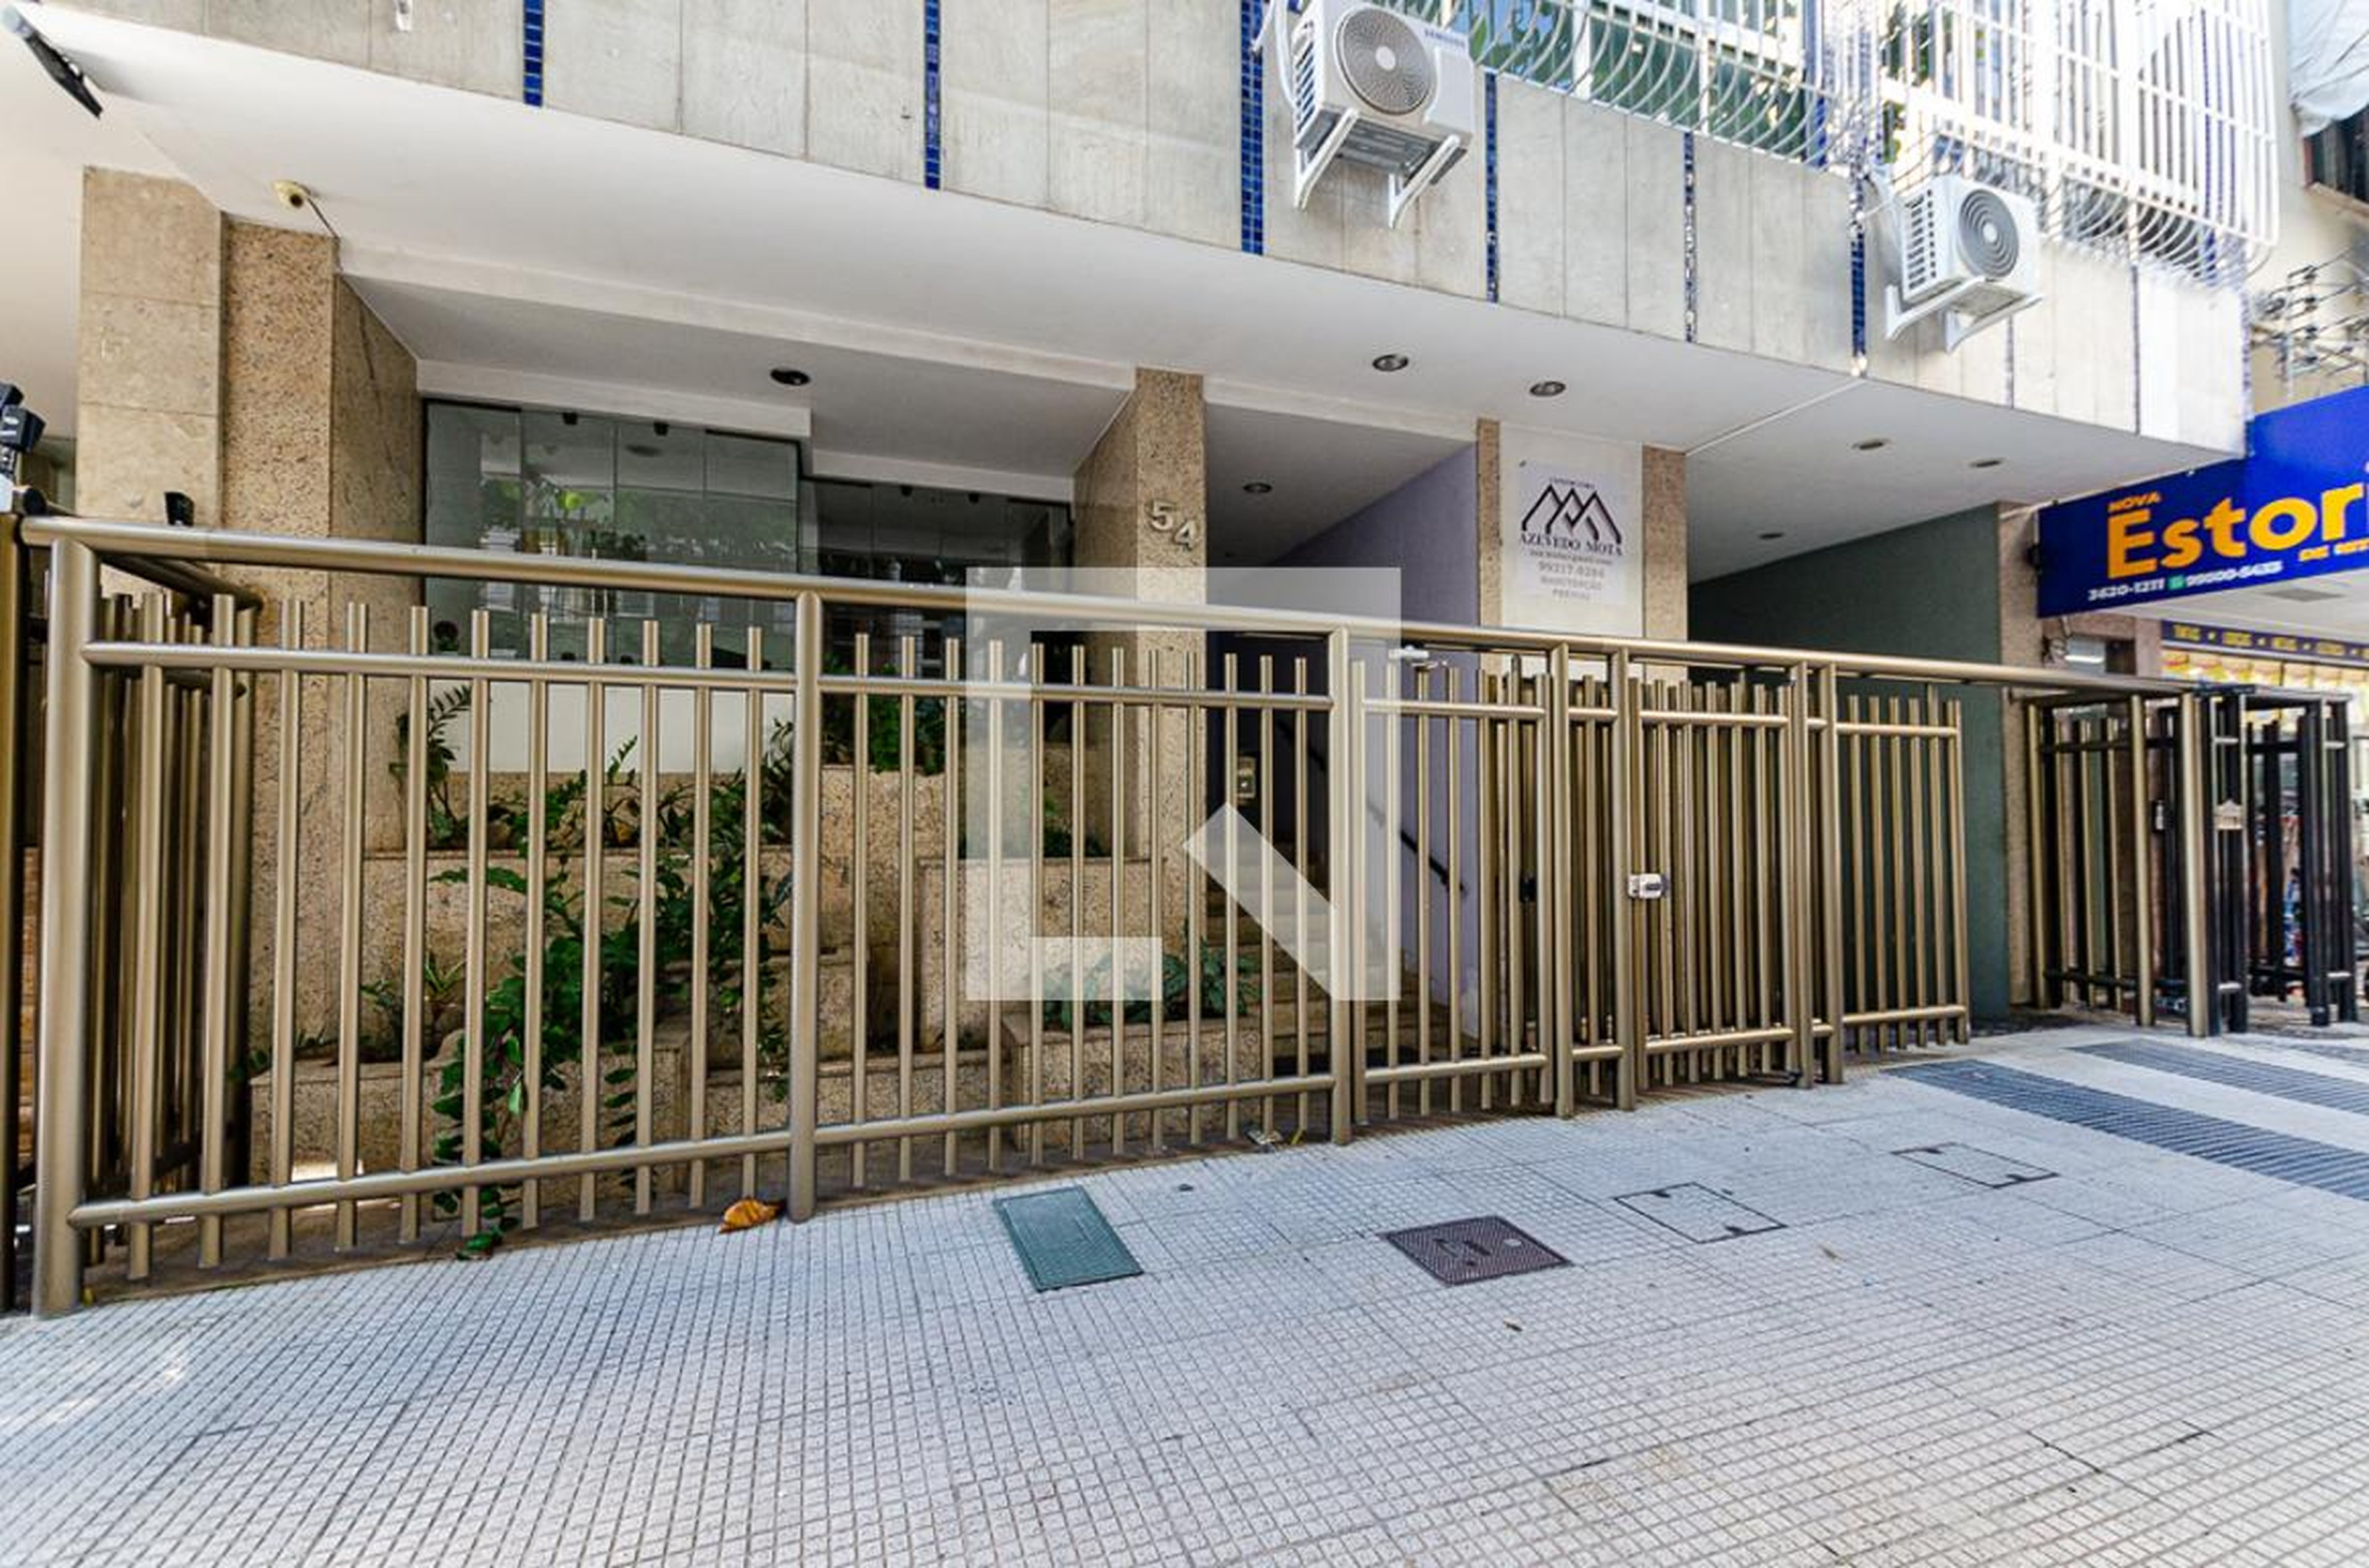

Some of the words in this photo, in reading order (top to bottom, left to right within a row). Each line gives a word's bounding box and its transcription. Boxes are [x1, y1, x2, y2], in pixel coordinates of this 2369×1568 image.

[2108, 492, 2161, 512] NOVA
[1147, 499, 1196, 551] 54
[2107, 483, 2369, 579] Estor
[1586, 540, 1623, 556] MOTA
